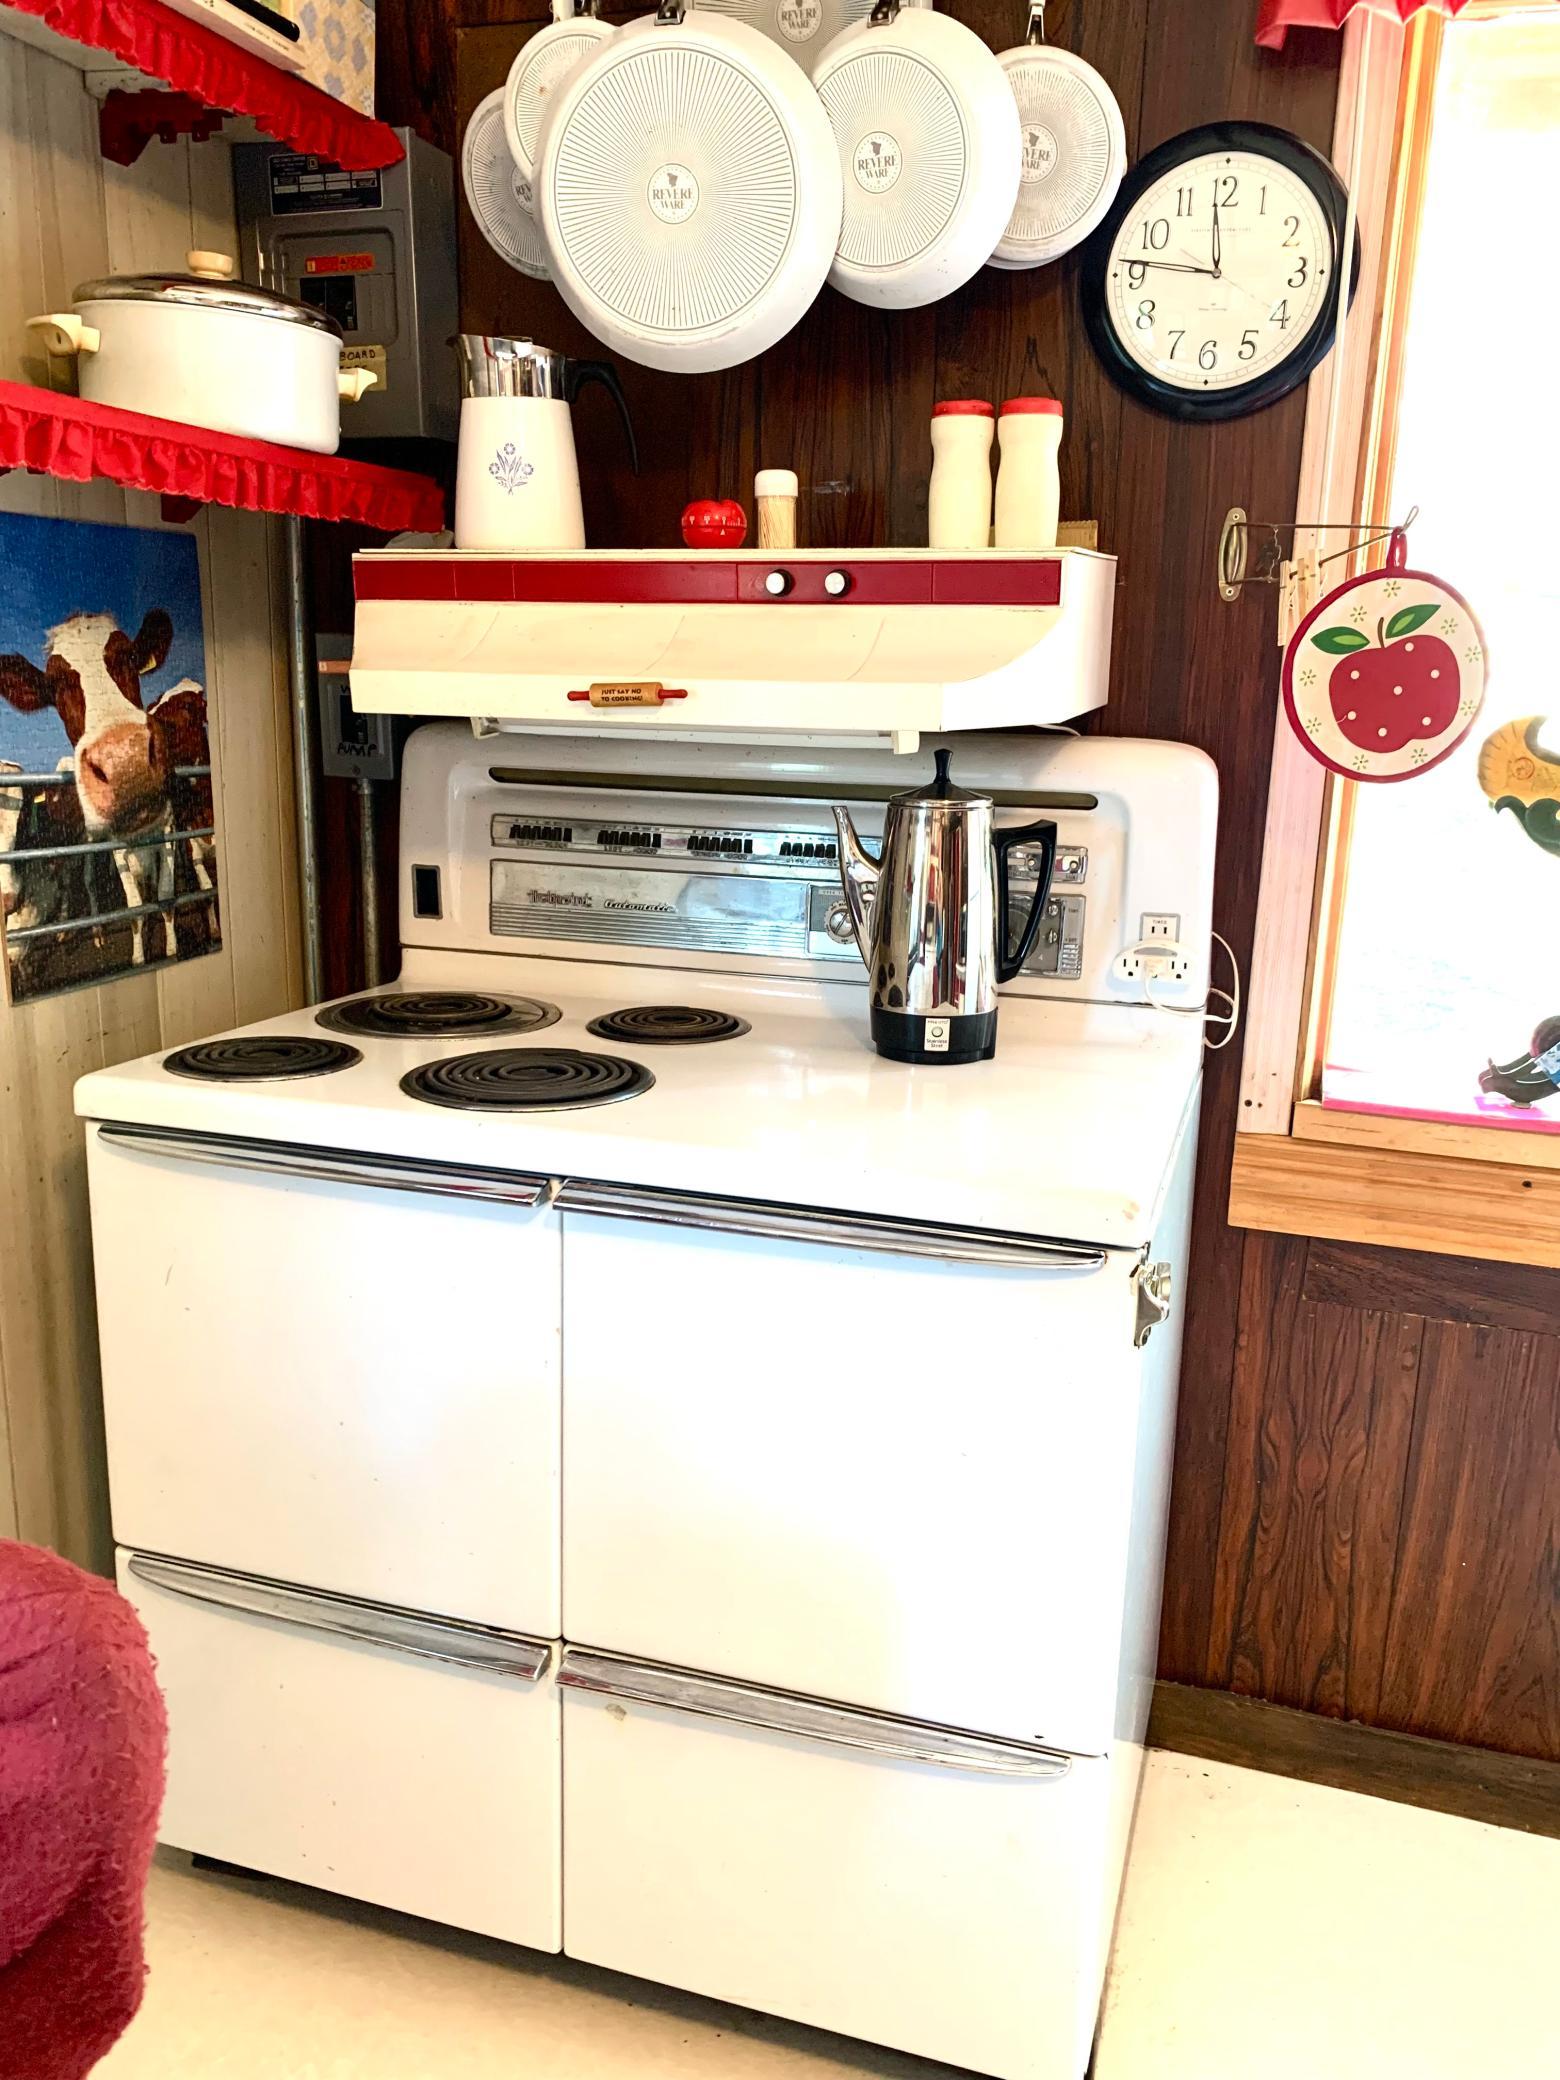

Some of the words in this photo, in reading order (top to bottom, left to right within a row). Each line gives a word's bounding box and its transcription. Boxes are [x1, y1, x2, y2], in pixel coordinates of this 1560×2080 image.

[781, 8, 816, 21] REVERE
[858, 155, 895, 170] REVERE
[865, 168, 887, 178] WARE
[652, 187, 693, 200] REVERE
[660, 199, 684, 209] WARE
[1176, 187, 1194, 217] 11
[1212, 175, 1240, 208] 12
[1259, 185, 1268, 215] 1
[1141, 218, 1170, 250] 10
[1282, 215, 1301, 248] 2
[1128, 260, 1146, 290] 9
[1287, 256, 1308, 289] 3
[1135, 300, 1156, 330] 8
[1269, 299, 1291, 330] 4
[1167, 330, 1186, 360] 7
[1198, 340, 1217, 370] 6
[1237, 329, 1259, 361] 5
[601, 688, 616, 696] JUST
[631, 687, 642, 695] NO
[337, 741, 377, 758] PUMP
